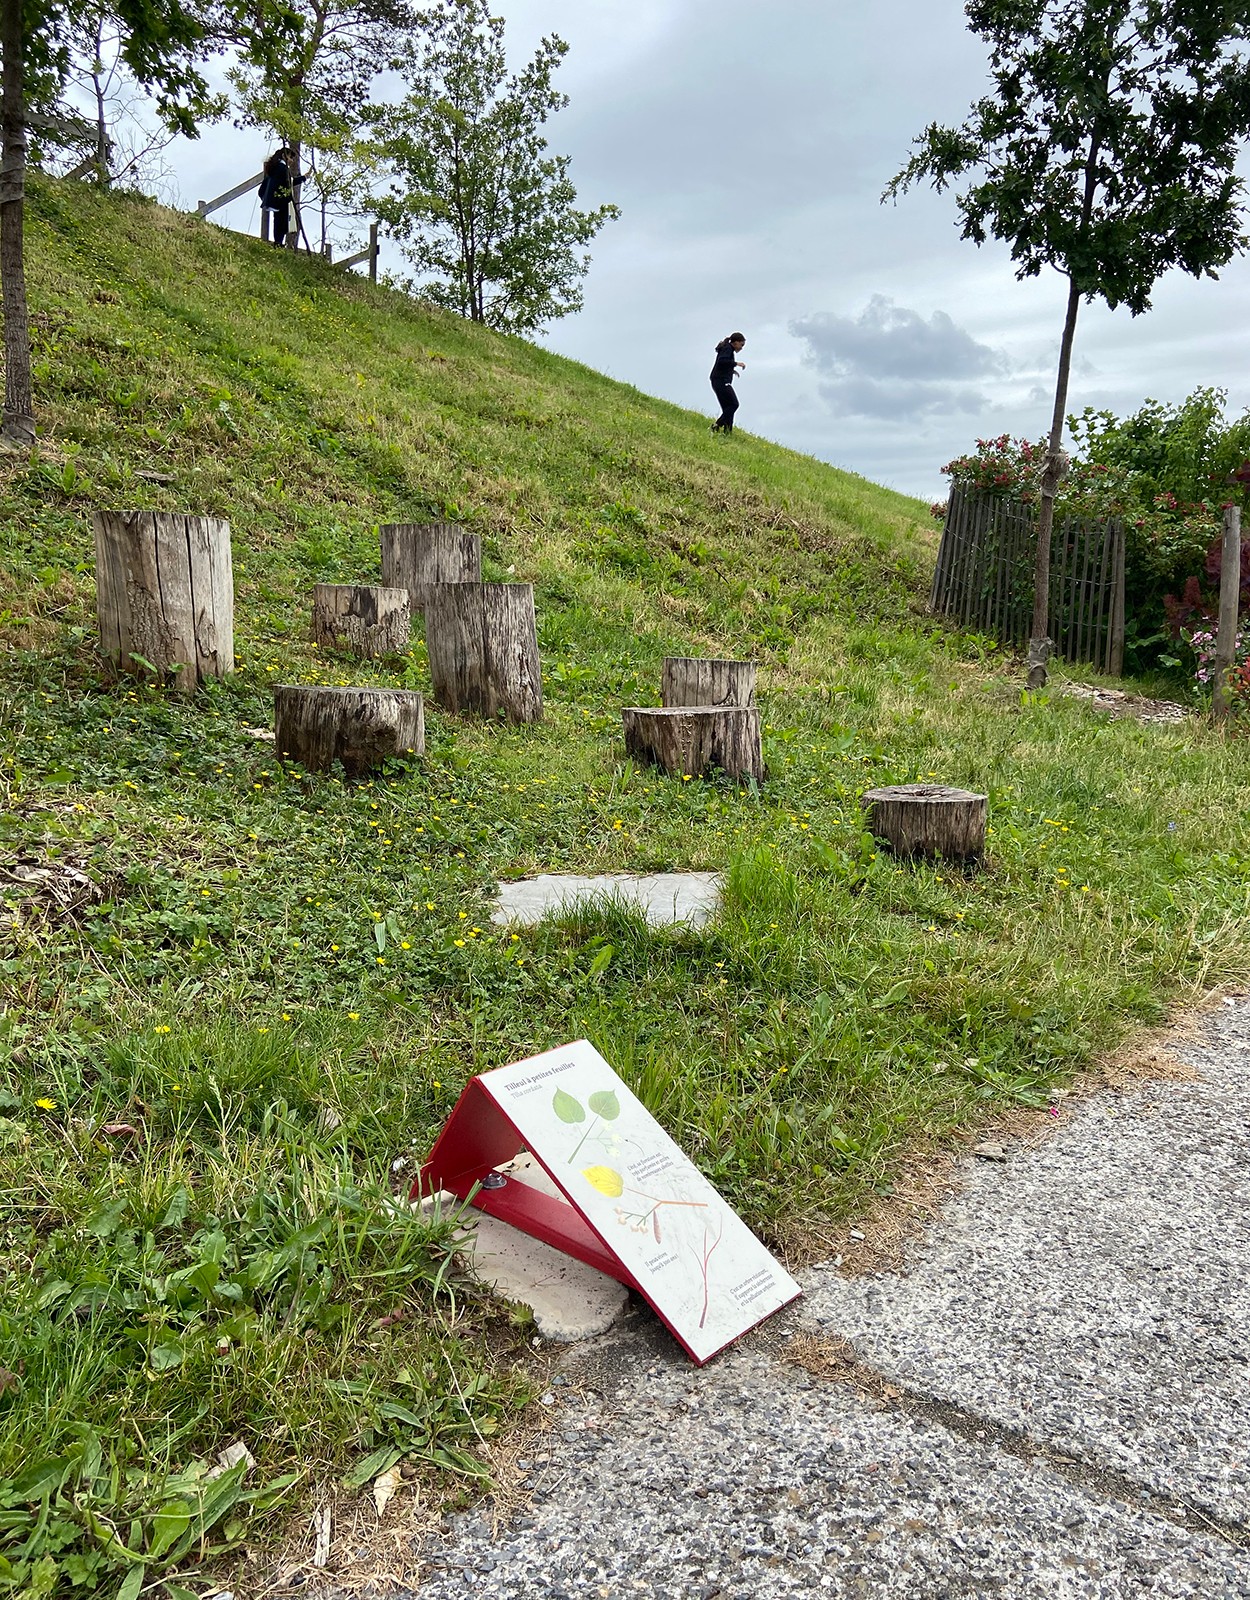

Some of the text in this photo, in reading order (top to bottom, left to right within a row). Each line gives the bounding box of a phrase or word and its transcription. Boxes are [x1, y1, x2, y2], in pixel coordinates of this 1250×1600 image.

[503, 1061, 576, 1092] Tilleul à petites feuilles
